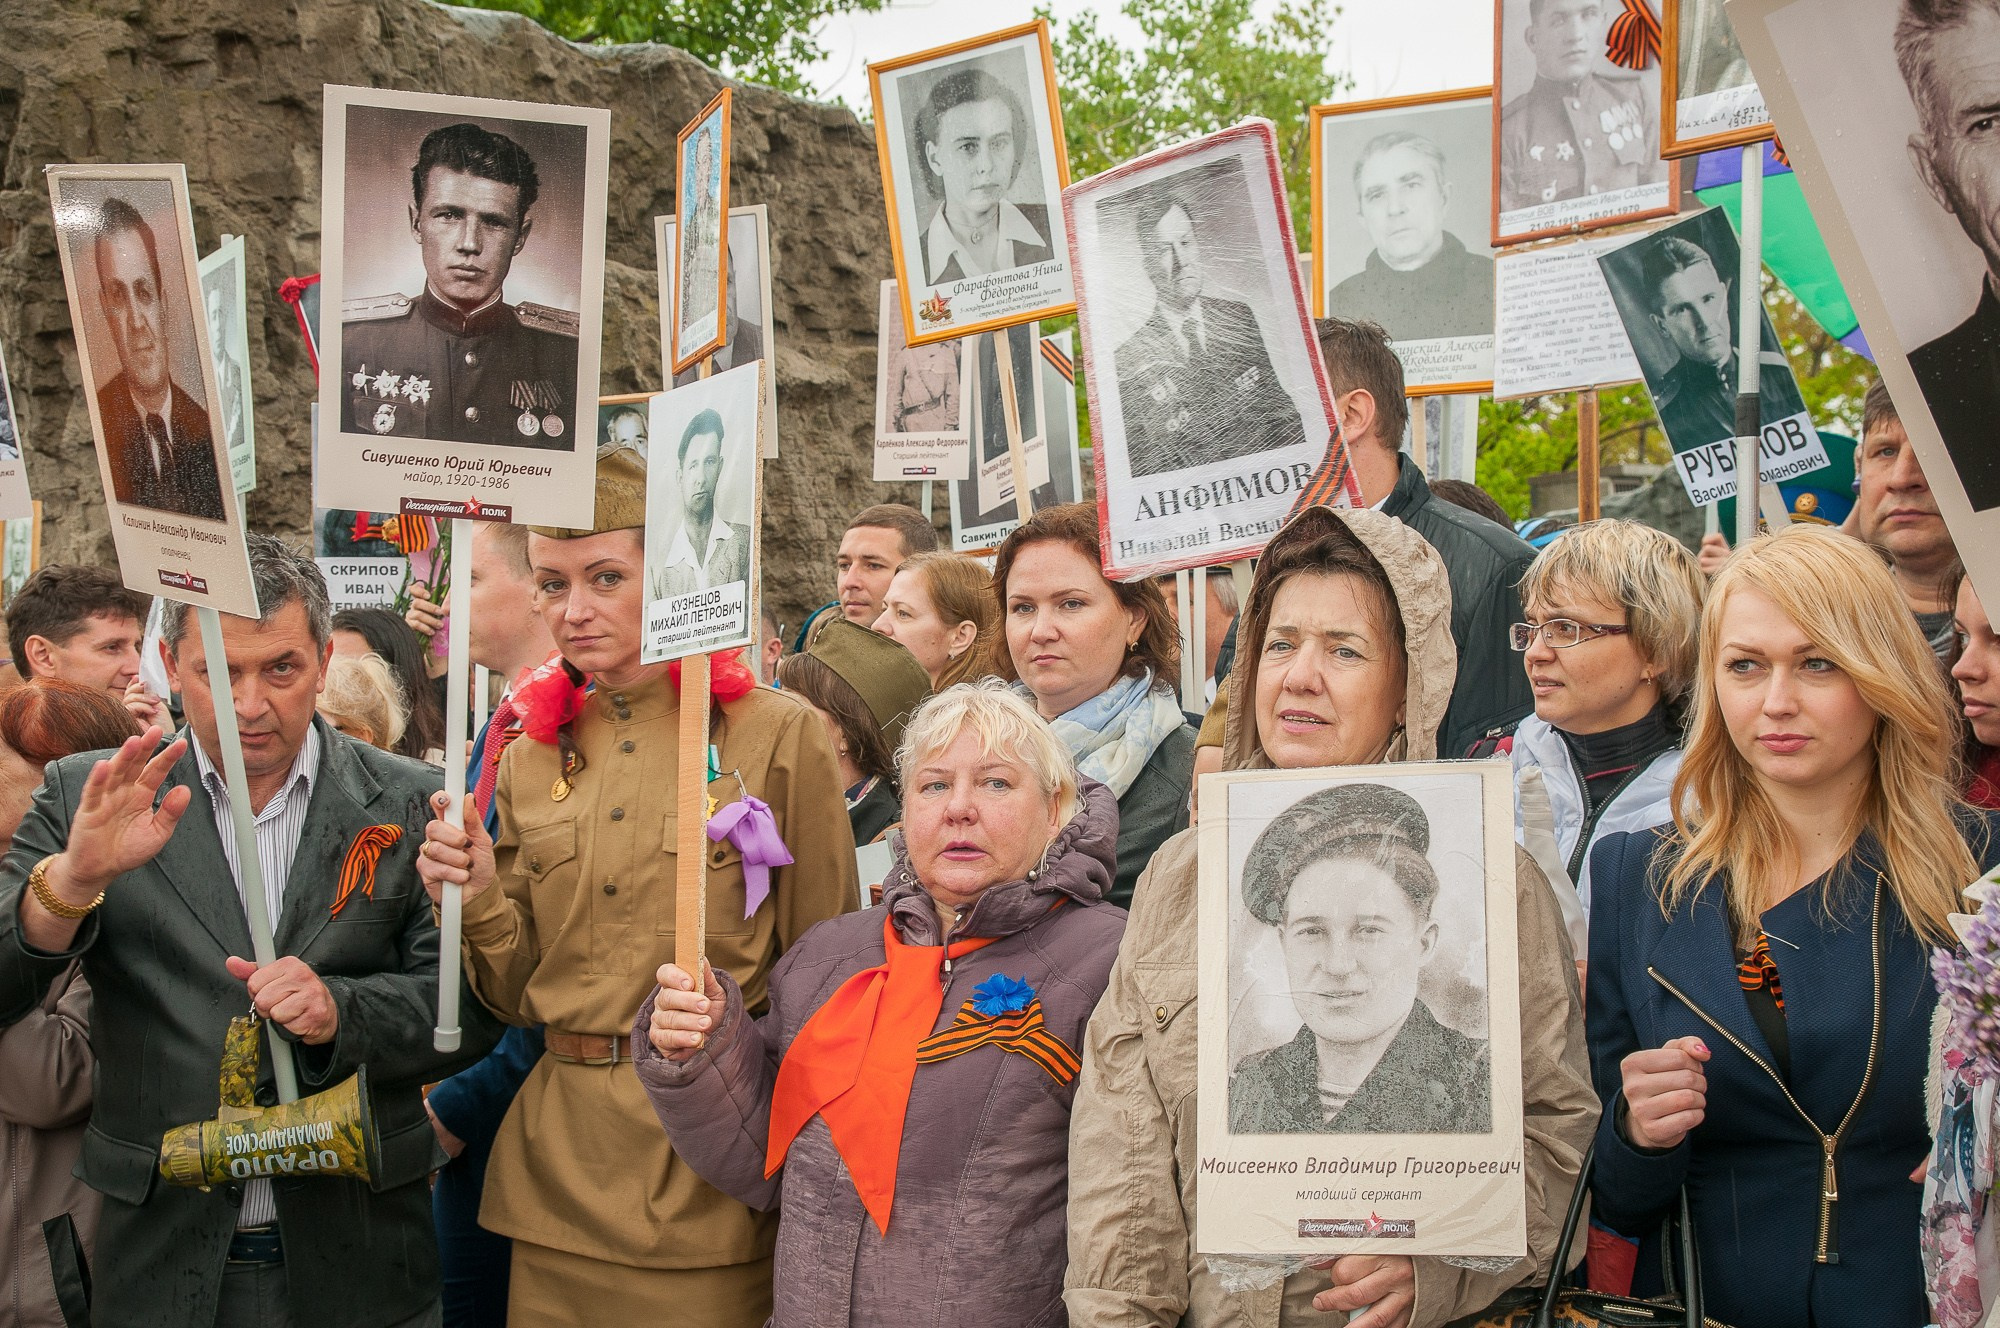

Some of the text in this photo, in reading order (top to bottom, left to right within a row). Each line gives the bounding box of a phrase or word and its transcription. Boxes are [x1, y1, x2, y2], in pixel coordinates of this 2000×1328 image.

[1727, 115, 1753, 128] 1907
[1537, 205, 1555, 216] ВОВ
[953, 263, 1063, 297] Фарафонтова Нина
[980, 280, 1039, 303] Фёдоровна
[1442, 338, 1494, 354] Алексей
[1401, 353, 1463, 368] Яковлевич
[906, 438, 936, 449] Александр
[936, 437, 969, 448] Федорович
[1681, 418, 1808, 484] РУБОВ
[361, 449, 553, 477] Сивушенко Юрий Юрьевич
[403, 471, 511, 490] майор, 1920-1986
[1691, 453, 1826, 504] Васил оманович
[1134, 462, 1313, 521] АНФИМОВ
[122, 513, 227, 545] Калинин Александр Иванович
[961, 531, 997, 544] Савкин
[1118, 516, 1285, 560] Николай Васил
[330, 565, 399, 576] СКРИПОВ
[344, 584, 385, 595] ИВАН
[671, 590, 721, 613] КУЗНЕЦОВ
[650, 600, 743, 633] МИХАИЛ ПЕТРОВИЧ
[657, 620, 736, 645] старший лейтенант
[226, 1120, 334, 1156] КОМАНДИРСКОЕ
[230, 1149, 340, 1179] ОРАЛО
[1200, 1156, 1522, 1178] Моисеенко Владимир Григорьевич
[1296, 1187, 1422, 1204] младший сержант
